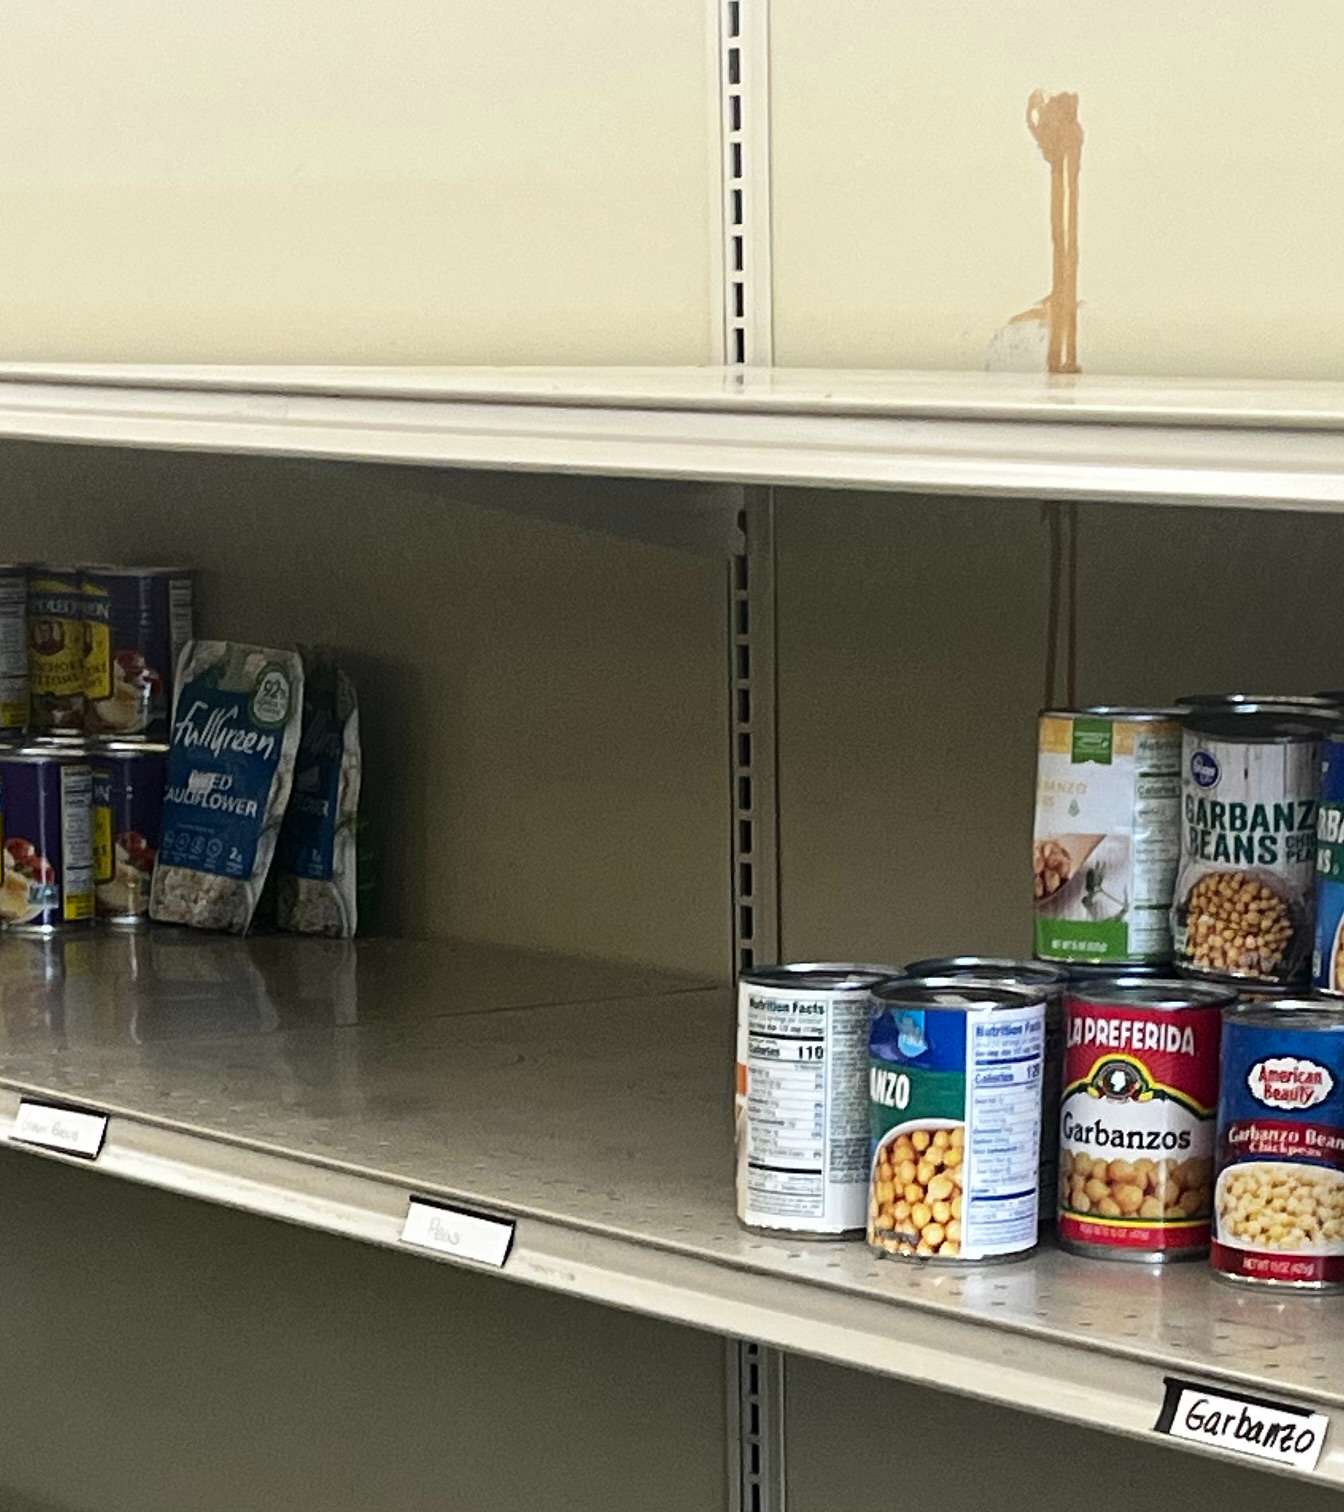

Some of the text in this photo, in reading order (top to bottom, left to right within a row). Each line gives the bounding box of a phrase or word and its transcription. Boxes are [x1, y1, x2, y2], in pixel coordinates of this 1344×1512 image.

[1188, 826, 1278, 866] BEANS
[1084, 1017, 1195, 1056] PREFERIDA
[798, 1046, 824, 1060] 110
[1259, 1064, 1323, 1085] American
[1263, 1084, 1315, 1104] Beauty
[1062, 1110, 1192, 1150] Garbanzos
[1228, 1124, 1300, 1143] Garbanzo
[1184, 1398, 1316, 1454] Garbanzo
